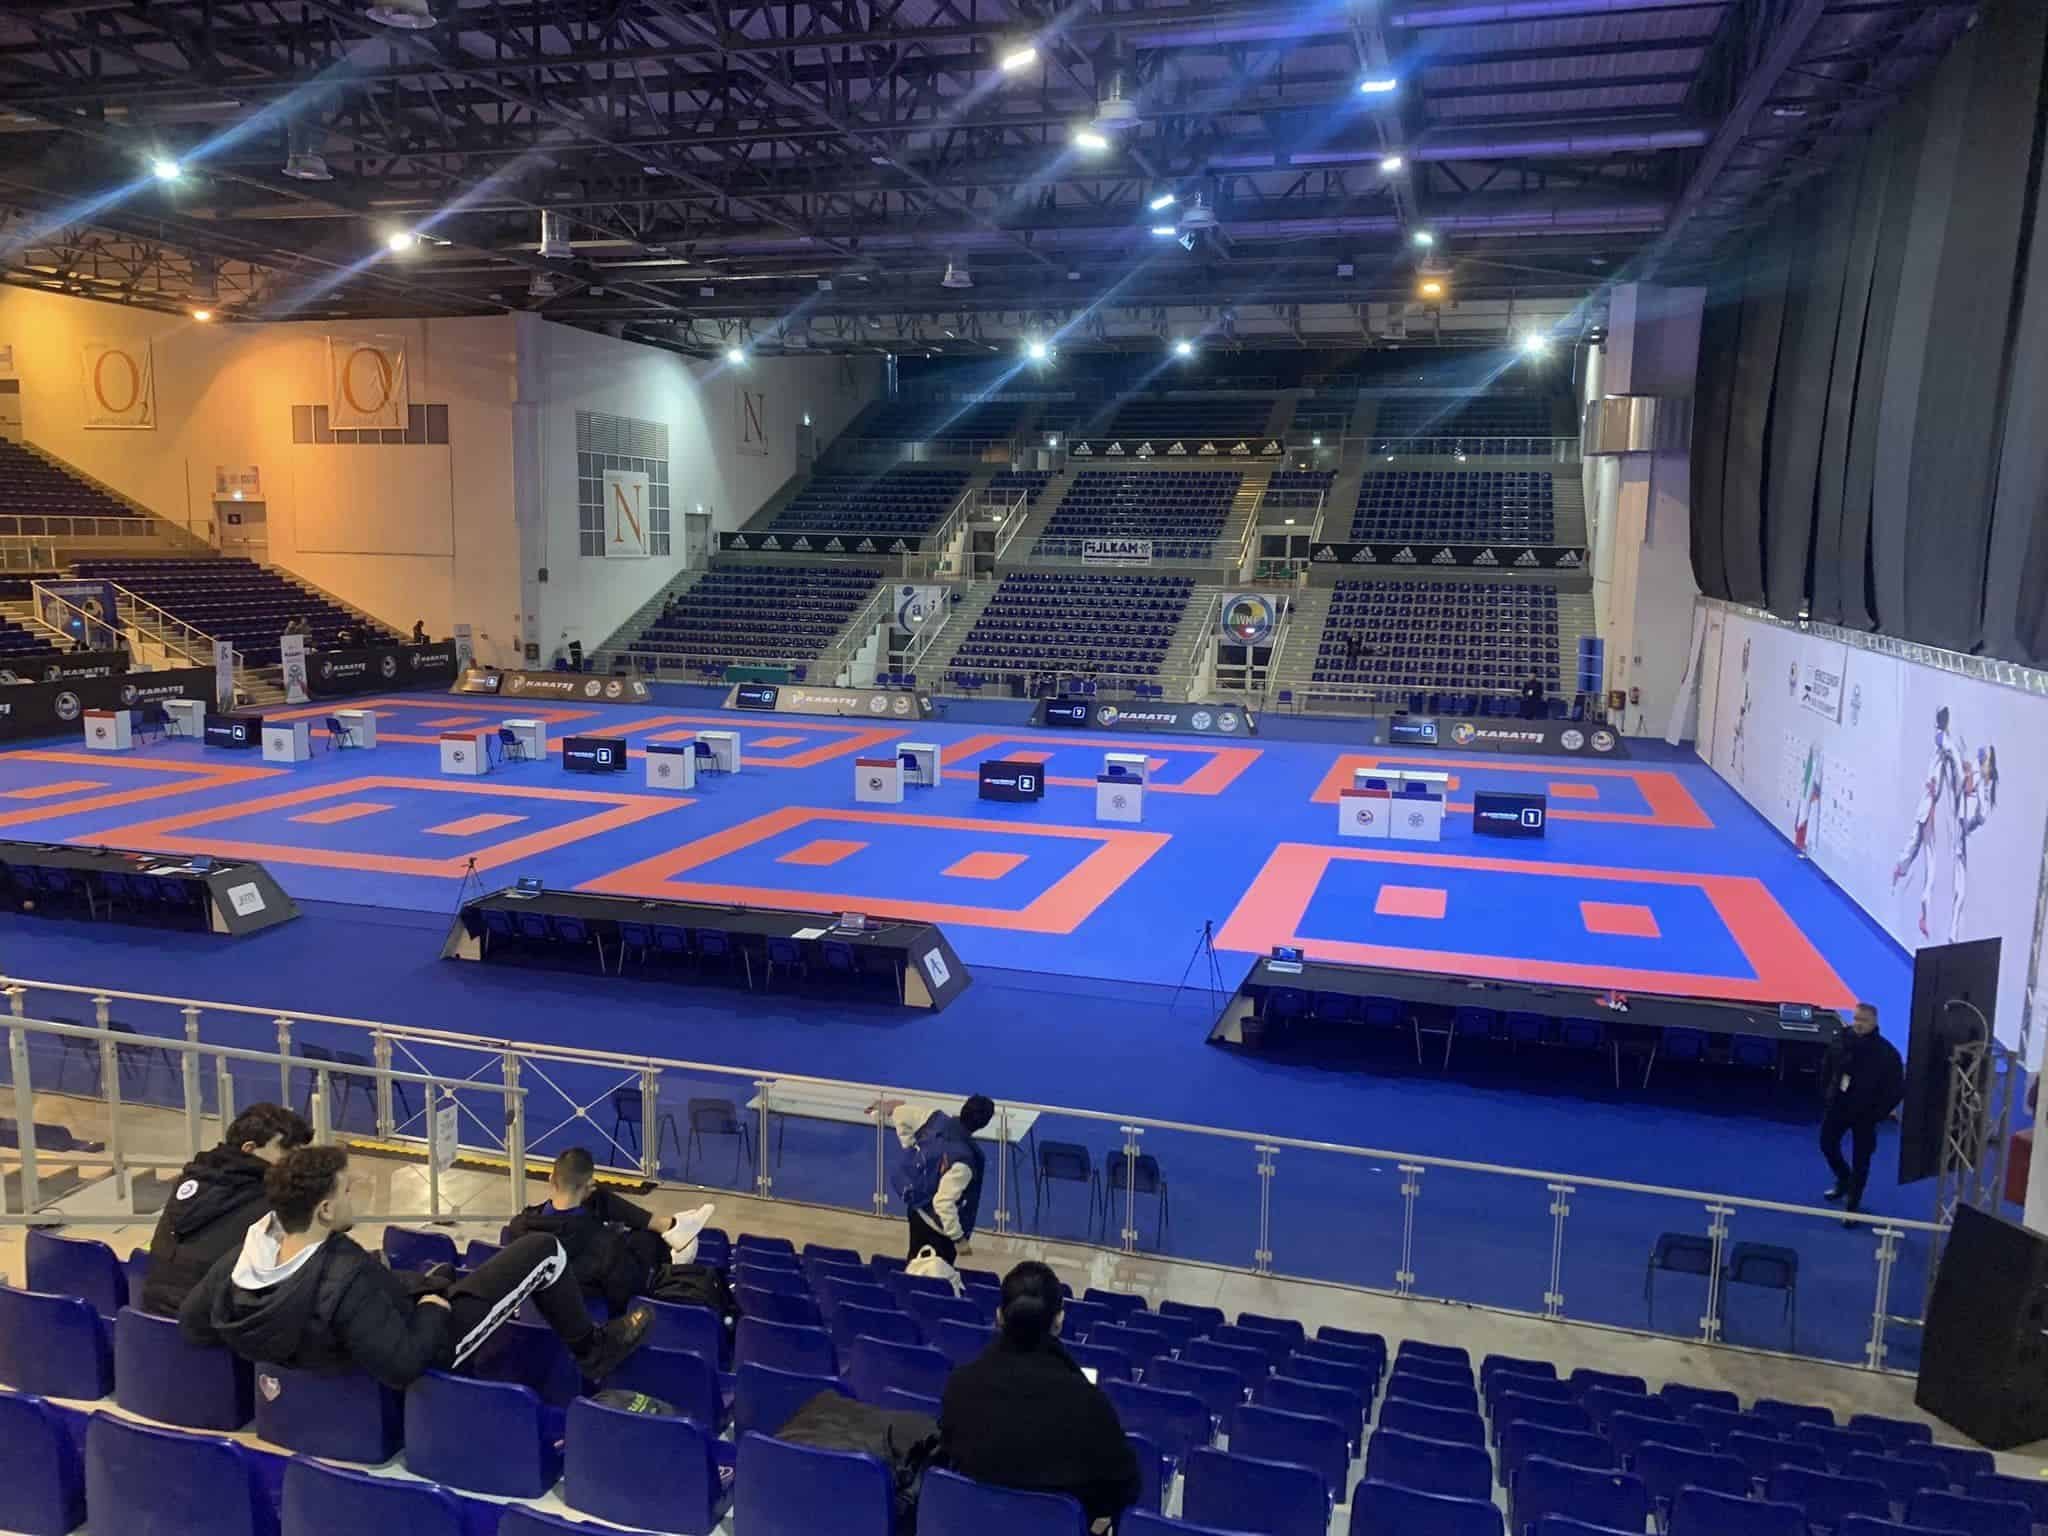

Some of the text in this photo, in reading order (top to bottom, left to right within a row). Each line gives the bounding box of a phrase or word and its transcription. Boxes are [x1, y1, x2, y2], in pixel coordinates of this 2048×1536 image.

[1084, 542, 1138, 553] FIJLKAM
[1119, 711, 1177, 724] KARATE1
[1476, 729, 1545, 744] KARATE1
